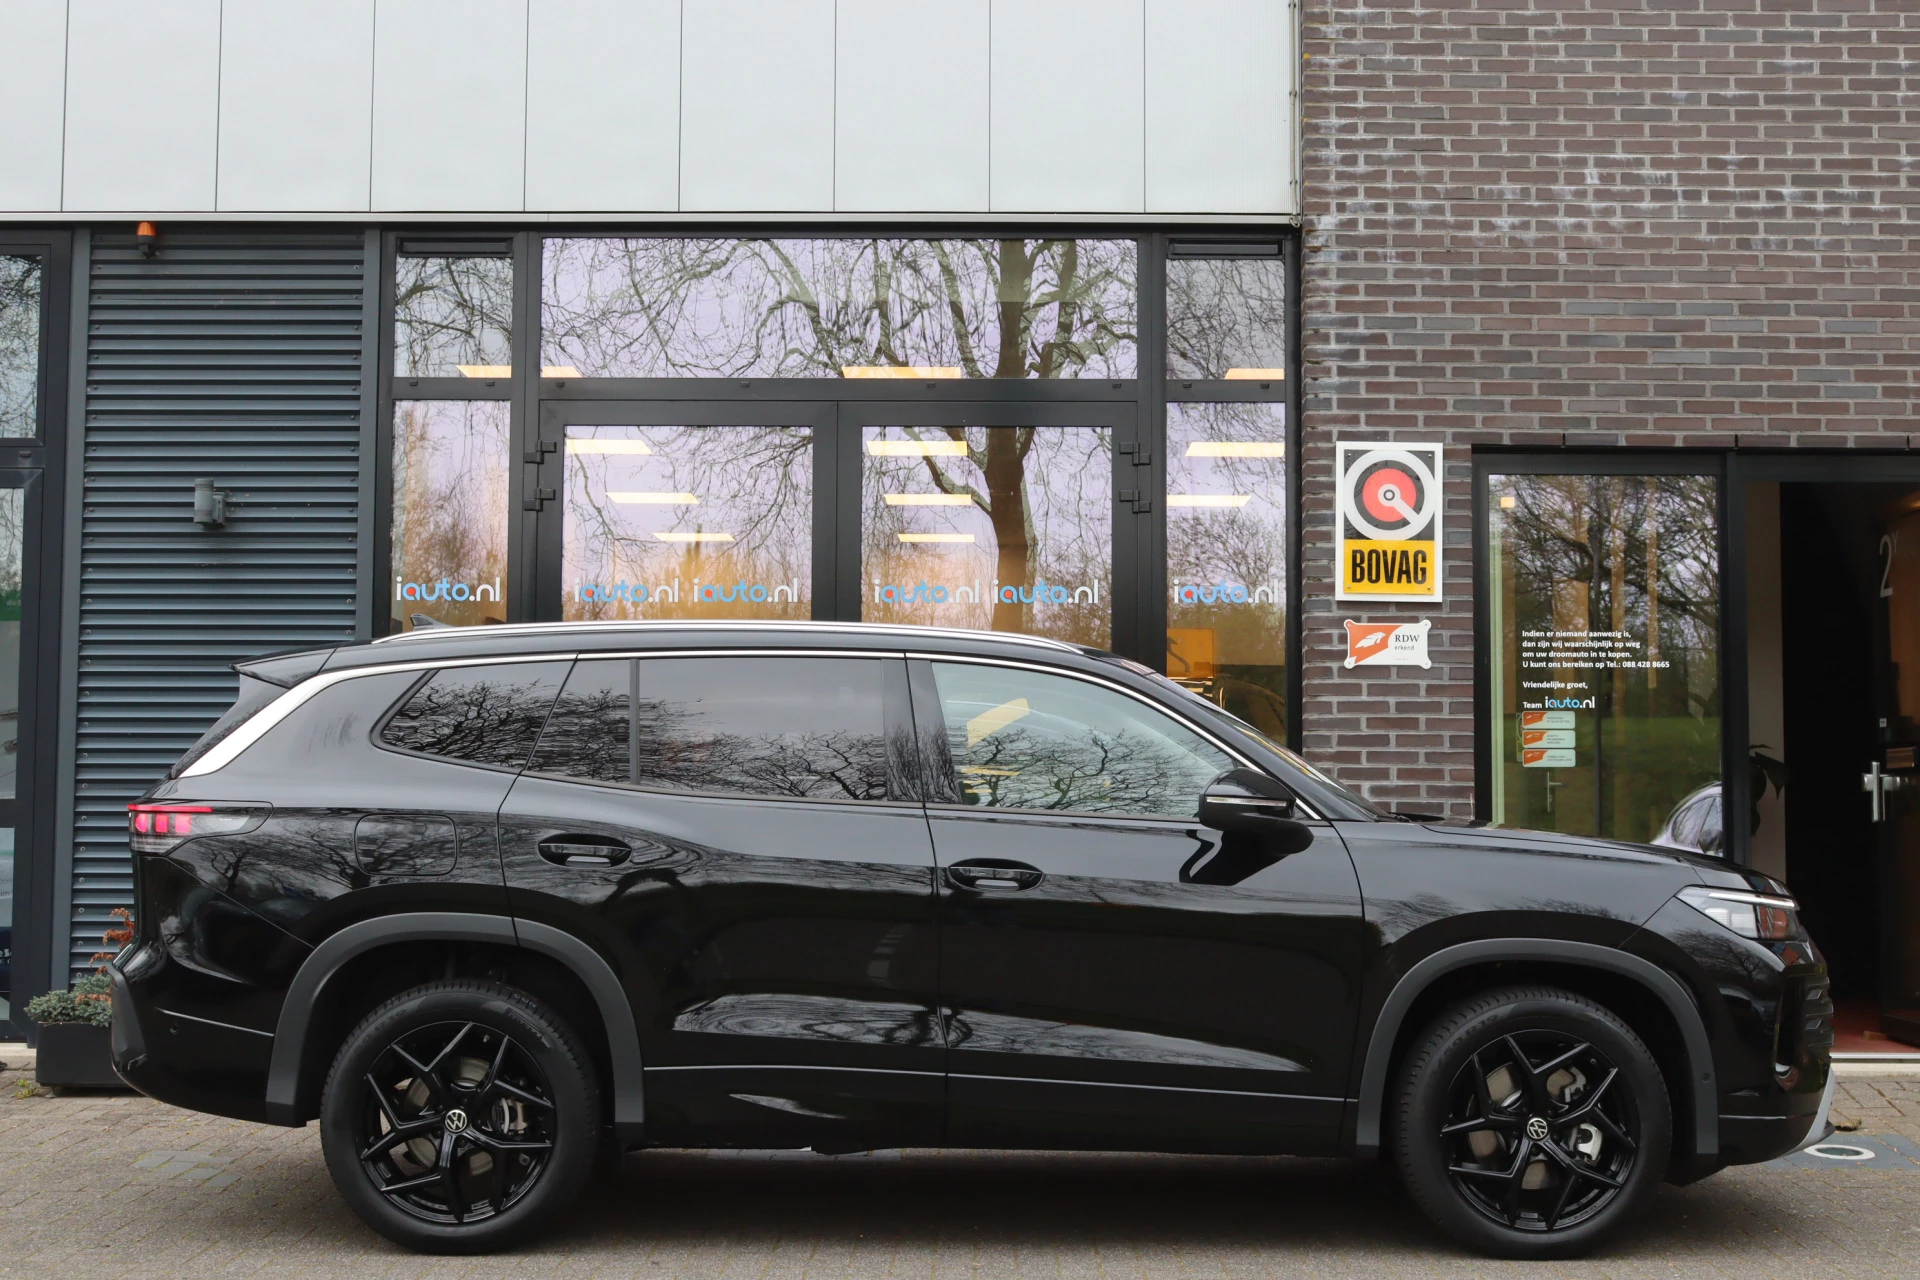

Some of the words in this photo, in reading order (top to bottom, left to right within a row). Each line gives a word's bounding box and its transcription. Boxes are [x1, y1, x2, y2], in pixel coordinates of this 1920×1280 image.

[1351, 548, 1427, 585] BOVAG
[396, 576, 501, 601] iauto.nl
[574, 578, 679, 603] iauto.nl
[693, 578, 798, 603] iauto.nl
[874, 579, 980, 603] iauto.nl
[993, 579, 1099, 603] iauto.nl
[1174, 579, 1279, 603] iauto.nl
[1394, 634, 1420, 643] RDW
[1522, 630, 1544, 638] Indien
[1556, 630, 1587, 638] niemand
[1588, 630, 1622, 639] aanwezig
[1623, 630, 1632, 639] is,
[1394, 644, 1415, 652] erkend
[1522, 640, 1536, 648] dan
[1537, 640, 1550, 649] zijn
[1552, 640, 1563, 649] wij
[1564, 640, 1613, 649] waarschijnlijk
[1608, 651, 1632, 659] kopen.
[1522, 681, 1565, 689] Vriendelijke
[1545, 696, 1595, 709] iauto.nl
